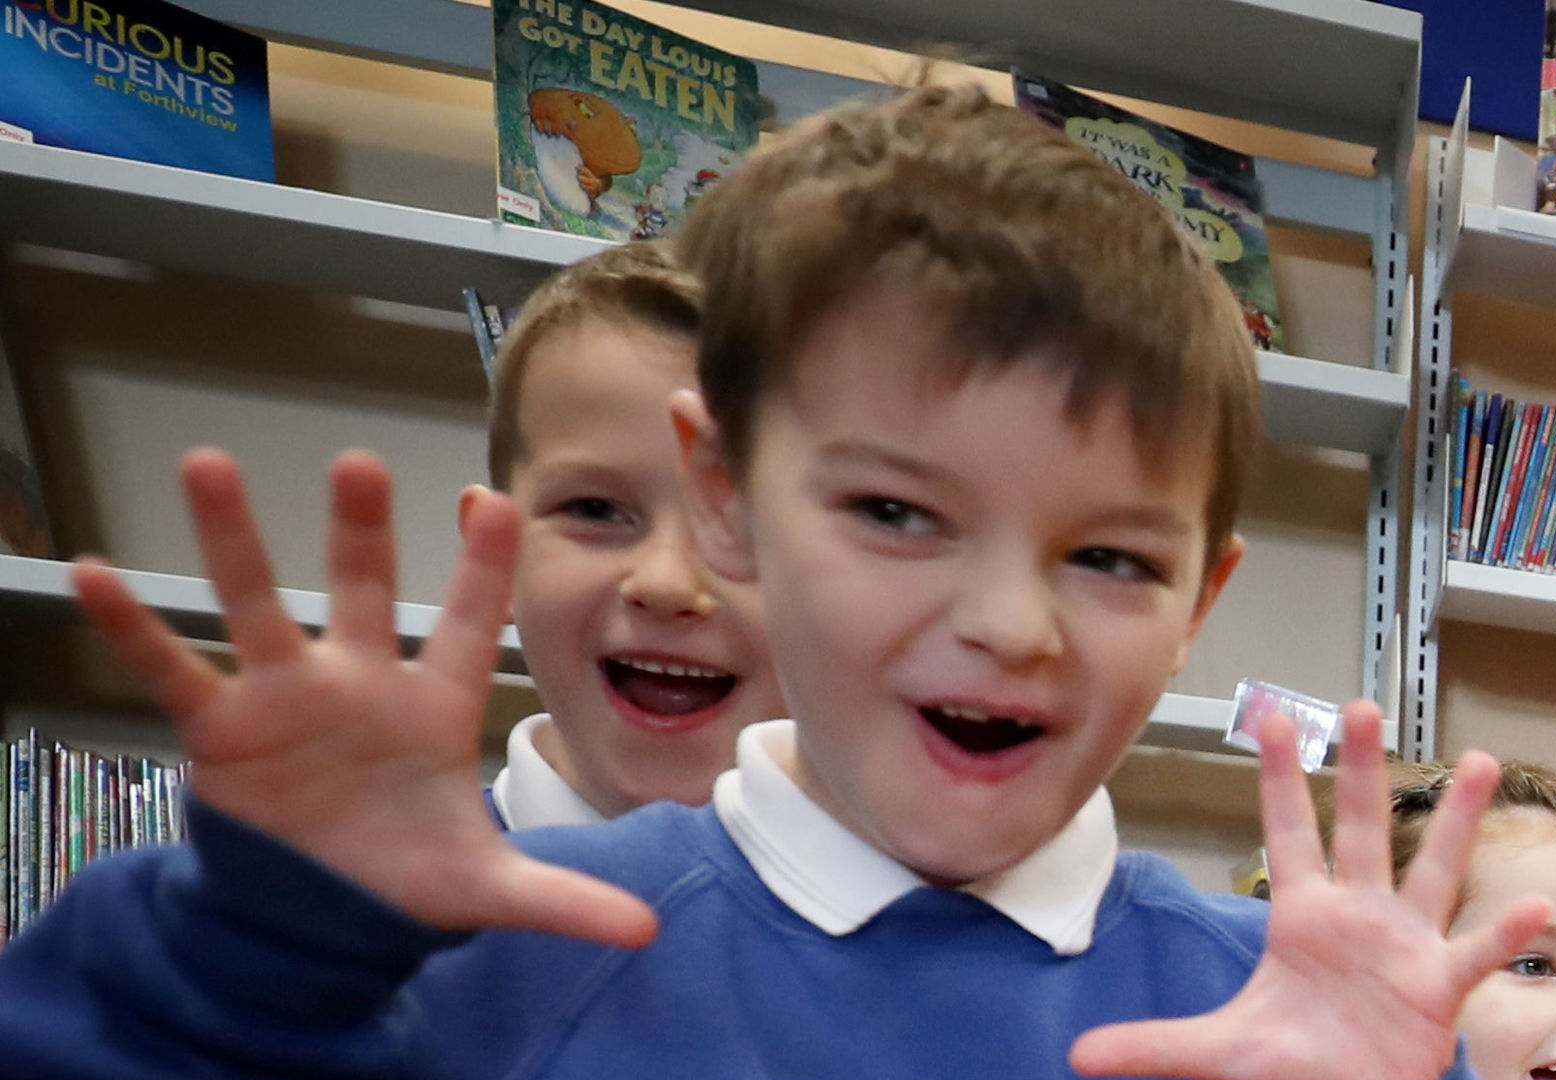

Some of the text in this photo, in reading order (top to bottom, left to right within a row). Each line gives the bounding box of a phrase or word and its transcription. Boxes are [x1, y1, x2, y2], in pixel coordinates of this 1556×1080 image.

[4, 5, 236, 116] INCIDENTS
[14, 0, 236, 85] URIOUS
[518, 16, 735, 132] GOT EATEN
[582, 8, 645, 51] DAY
[651, 36, 737, 88] LOUIS
[93, 72, 238, 132] at Forthview
